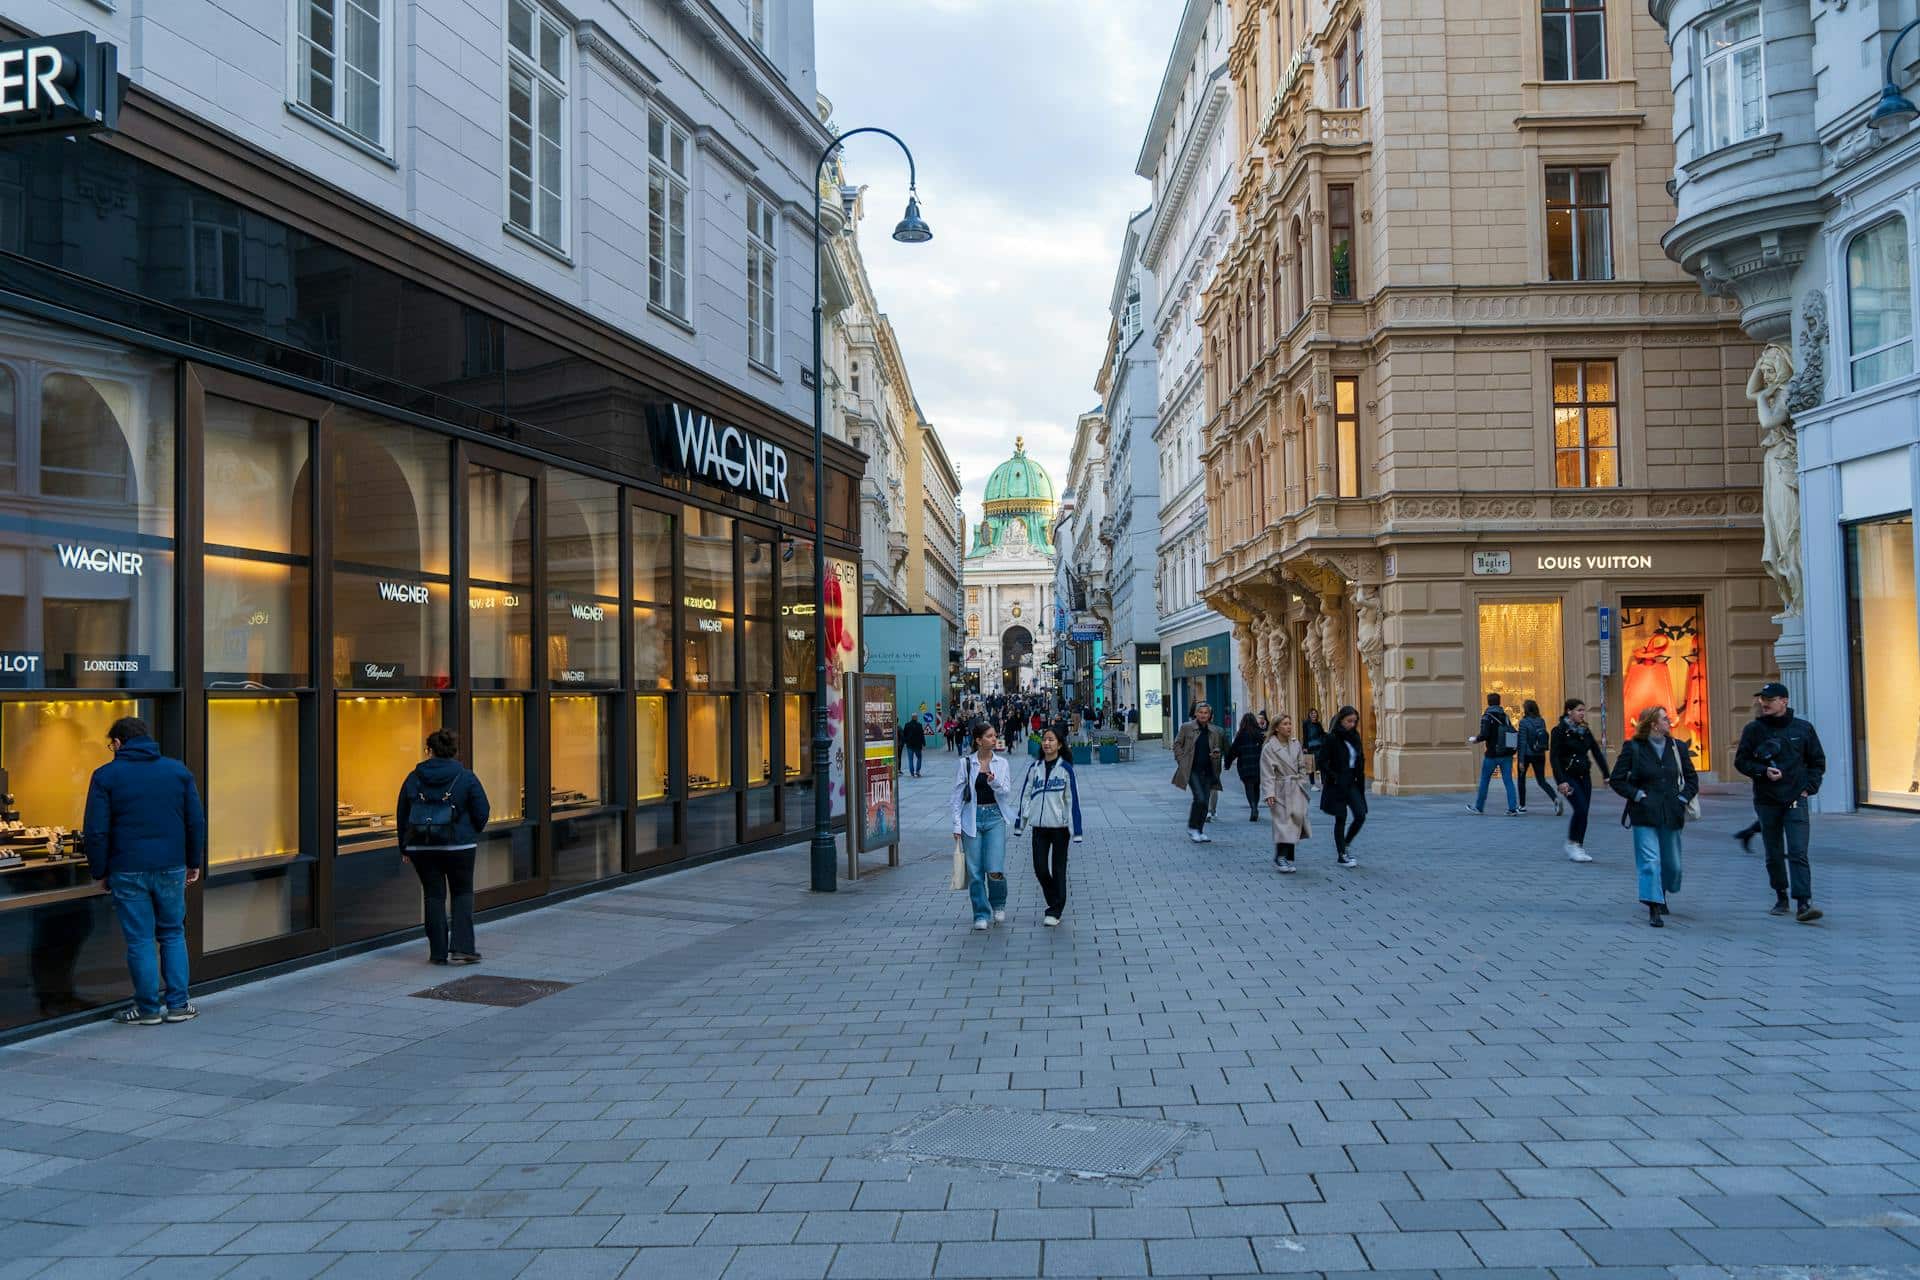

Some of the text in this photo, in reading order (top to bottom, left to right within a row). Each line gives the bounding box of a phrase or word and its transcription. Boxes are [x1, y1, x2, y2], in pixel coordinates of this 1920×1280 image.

[0, 46, 65, 113] ER
[673, 402, 789, 503] WAGNER
[57, 543, 143, 576] WAGNER
[1537, 555, 1652, 570] LOUIS VUITTON
[379, 582, 429, 604] WAGNER
[571, 604, 604, 621] WAGNER
[84, 660, 139, 672] LONGINES
[364, 663, 397, 681] Chopard
[561, 670, 585, 682] WAGNER
